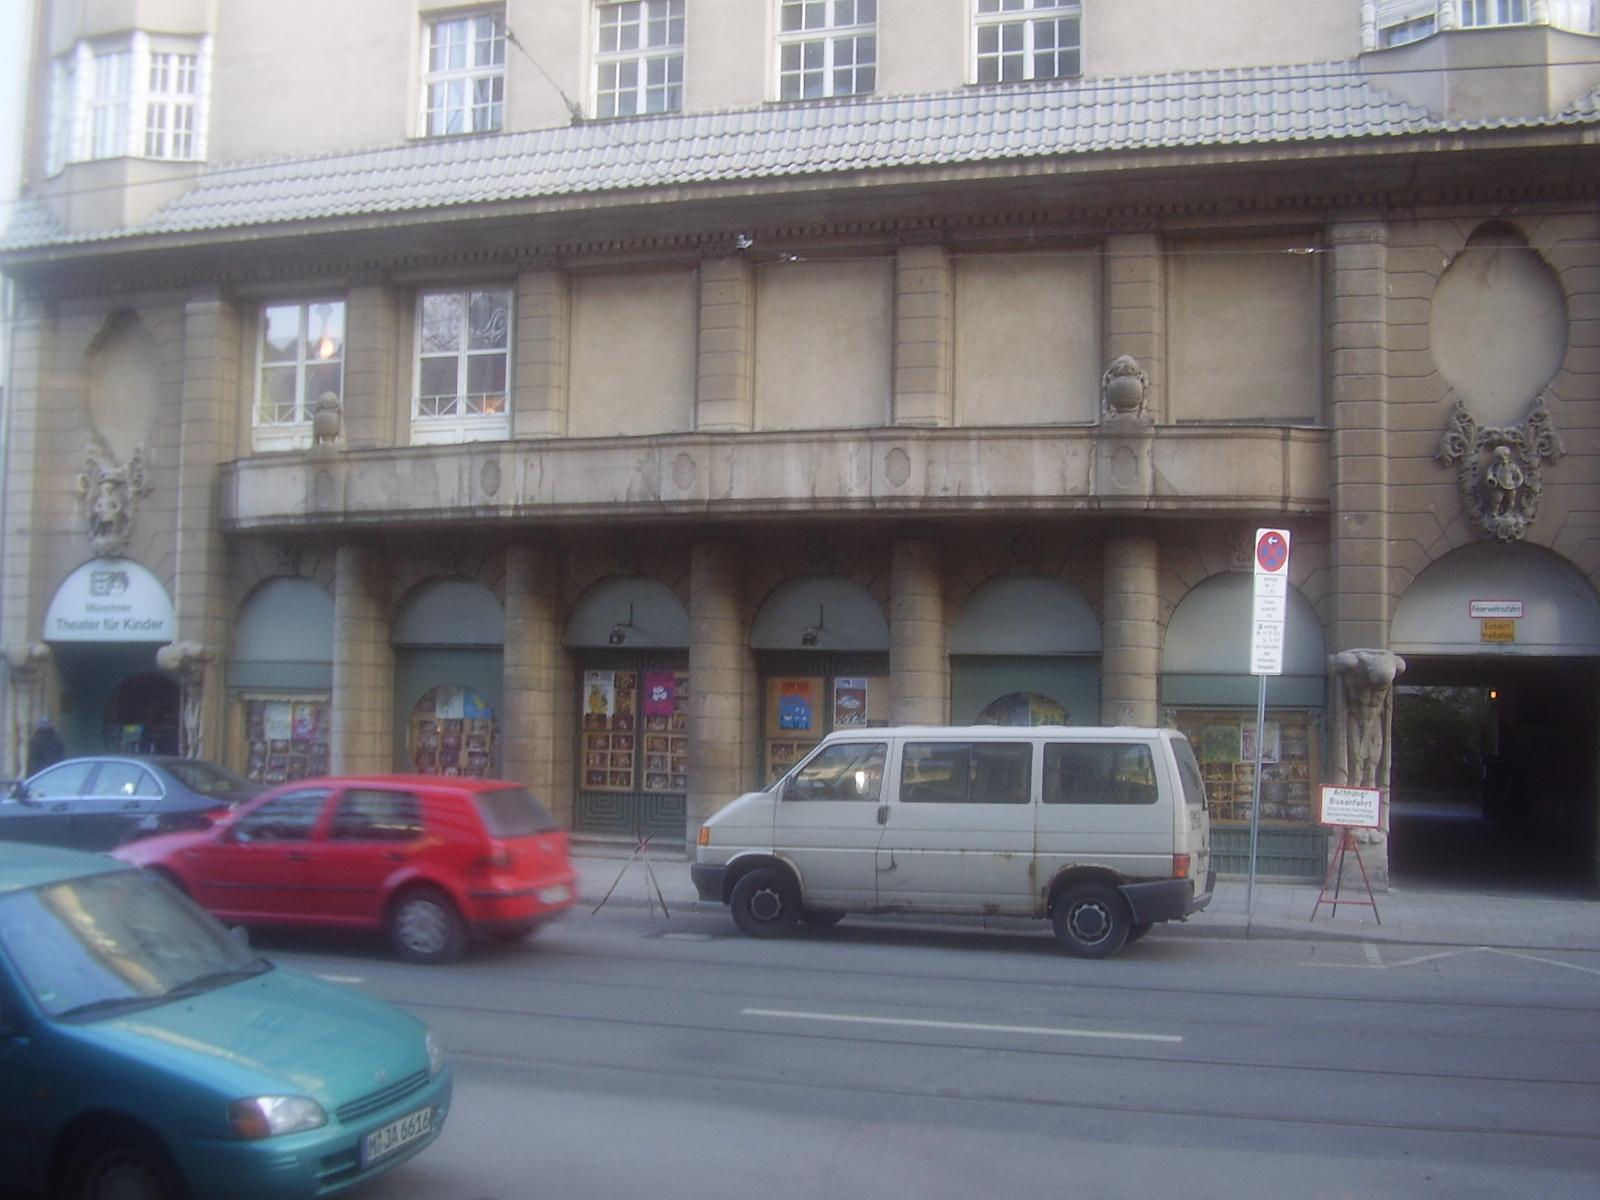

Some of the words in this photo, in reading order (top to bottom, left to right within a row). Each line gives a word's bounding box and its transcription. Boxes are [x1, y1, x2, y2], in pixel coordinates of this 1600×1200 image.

[56, 618, 100, 630] Theater
[103, 617, 119, 630] für
[123, 617, 164, 630] Kinder
